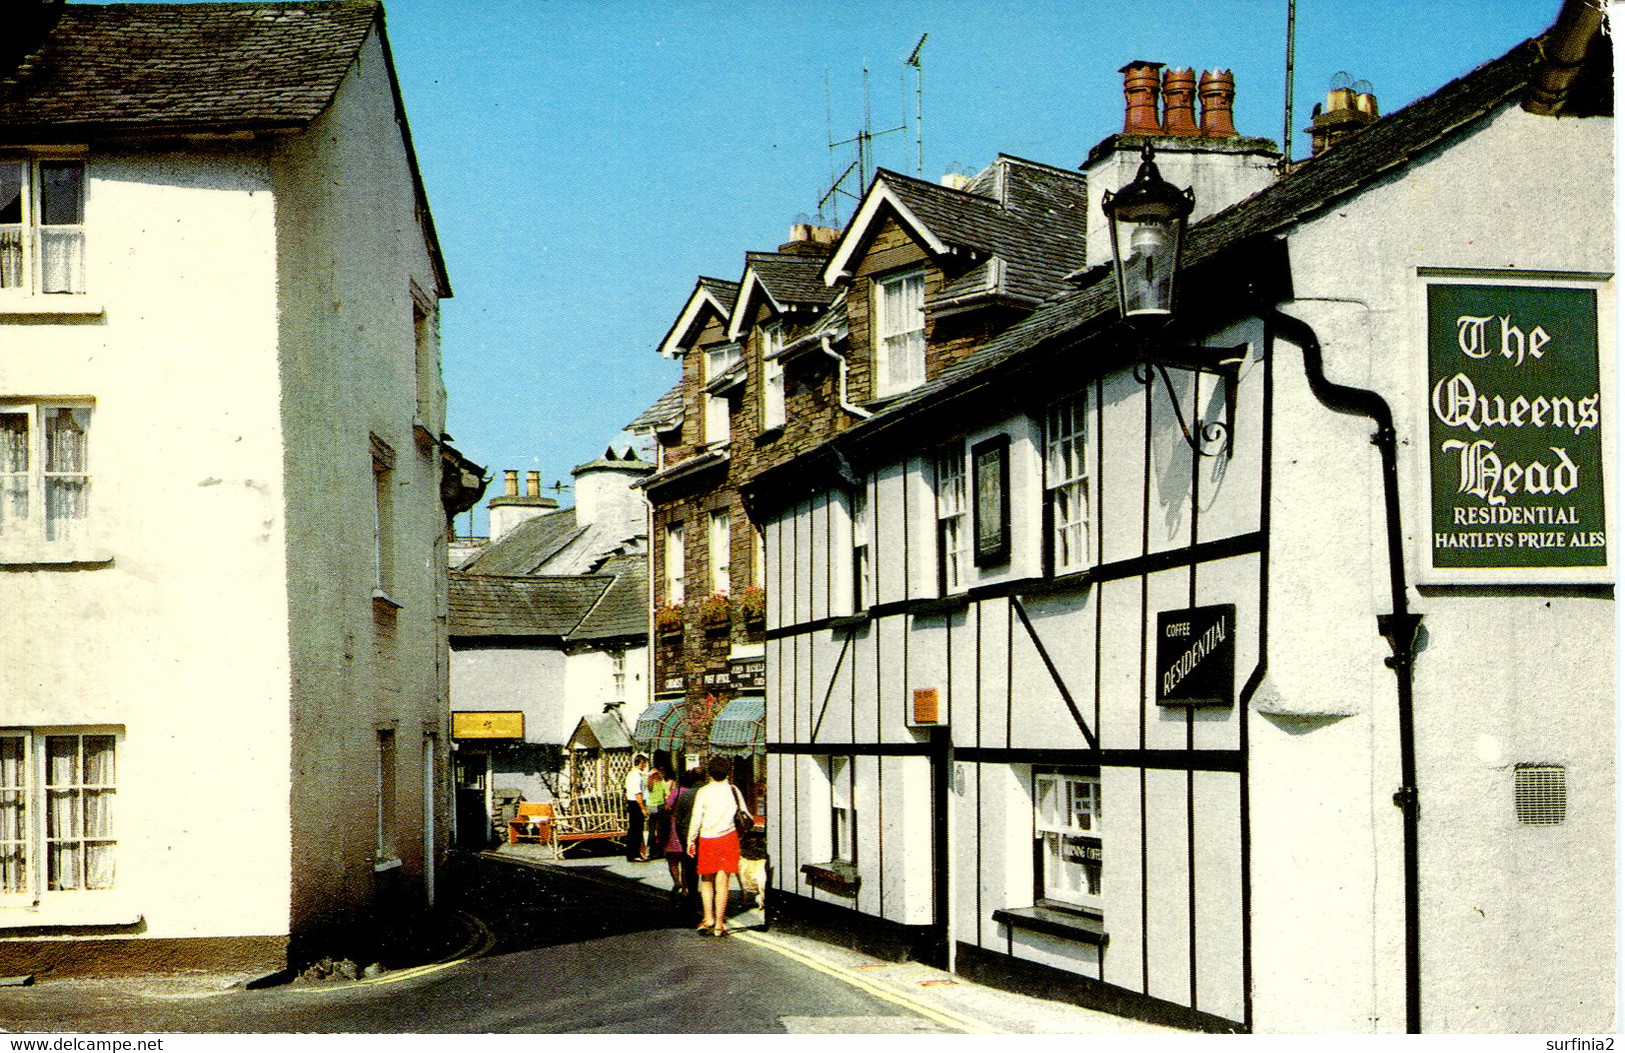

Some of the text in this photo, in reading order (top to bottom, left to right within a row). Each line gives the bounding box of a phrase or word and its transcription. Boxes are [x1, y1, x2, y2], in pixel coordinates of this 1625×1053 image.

[1457, 314, 1551, 367] The
[1432, 372, 1599, 435] Queens
[1442, 439, 1580, 506] Head
[1435, 531, 1606, 549] HARTLEYS PRIZE ALES
[1454, 506, 1579, 525] RESIDENTIAL
[1164, 615, 1226, 696] RESIDENTIAL
[1166, 622, 1190, 637] COFFEE
